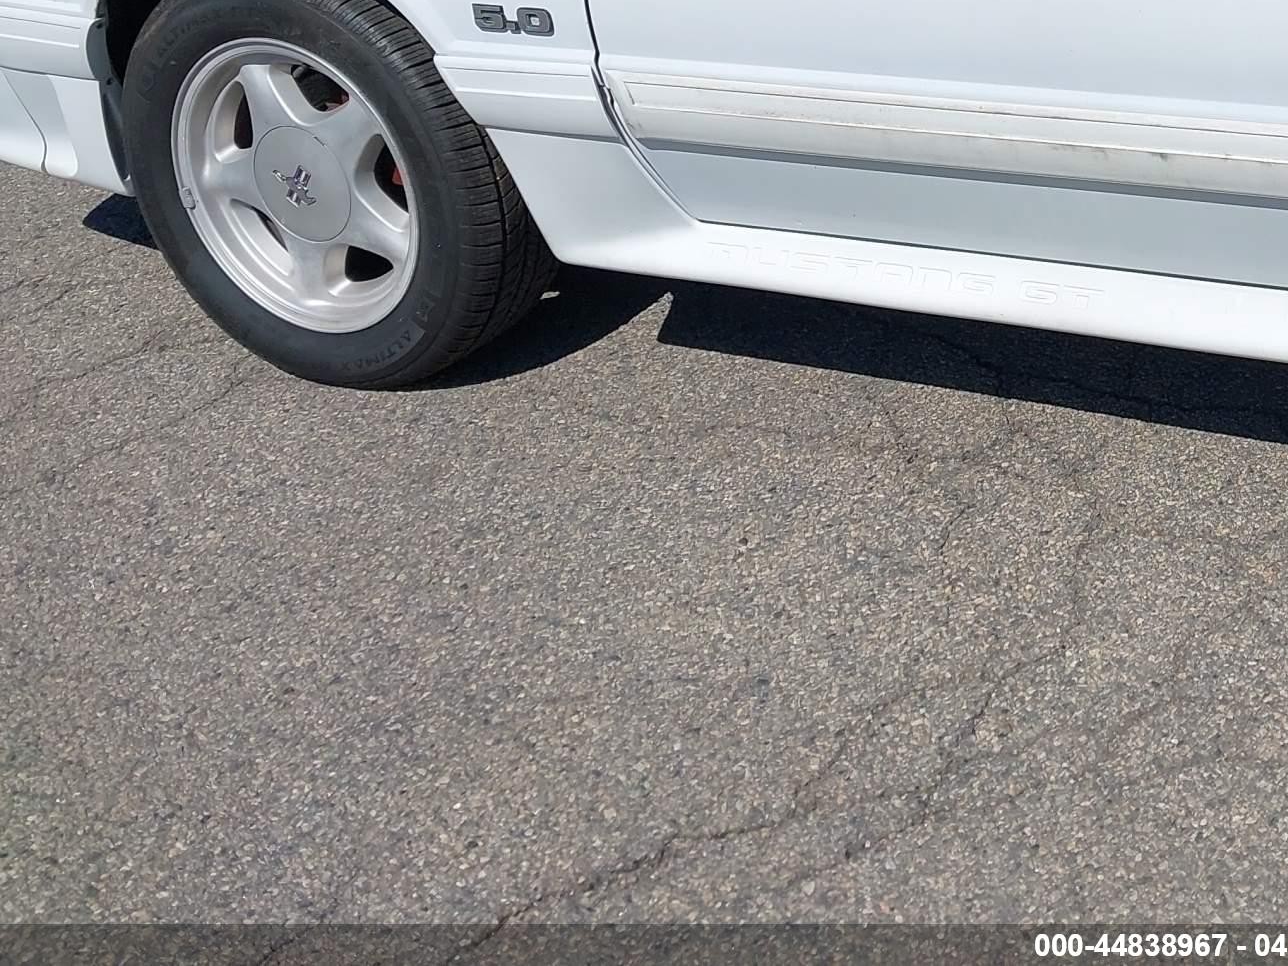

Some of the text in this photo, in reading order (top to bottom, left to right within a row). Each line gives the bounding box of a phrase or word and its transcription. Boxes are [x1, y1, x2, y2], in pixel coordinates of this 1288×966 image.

[472, 3, 555, 37] 5.0
[704, 240, 1106, 311] MUSTANG GT
